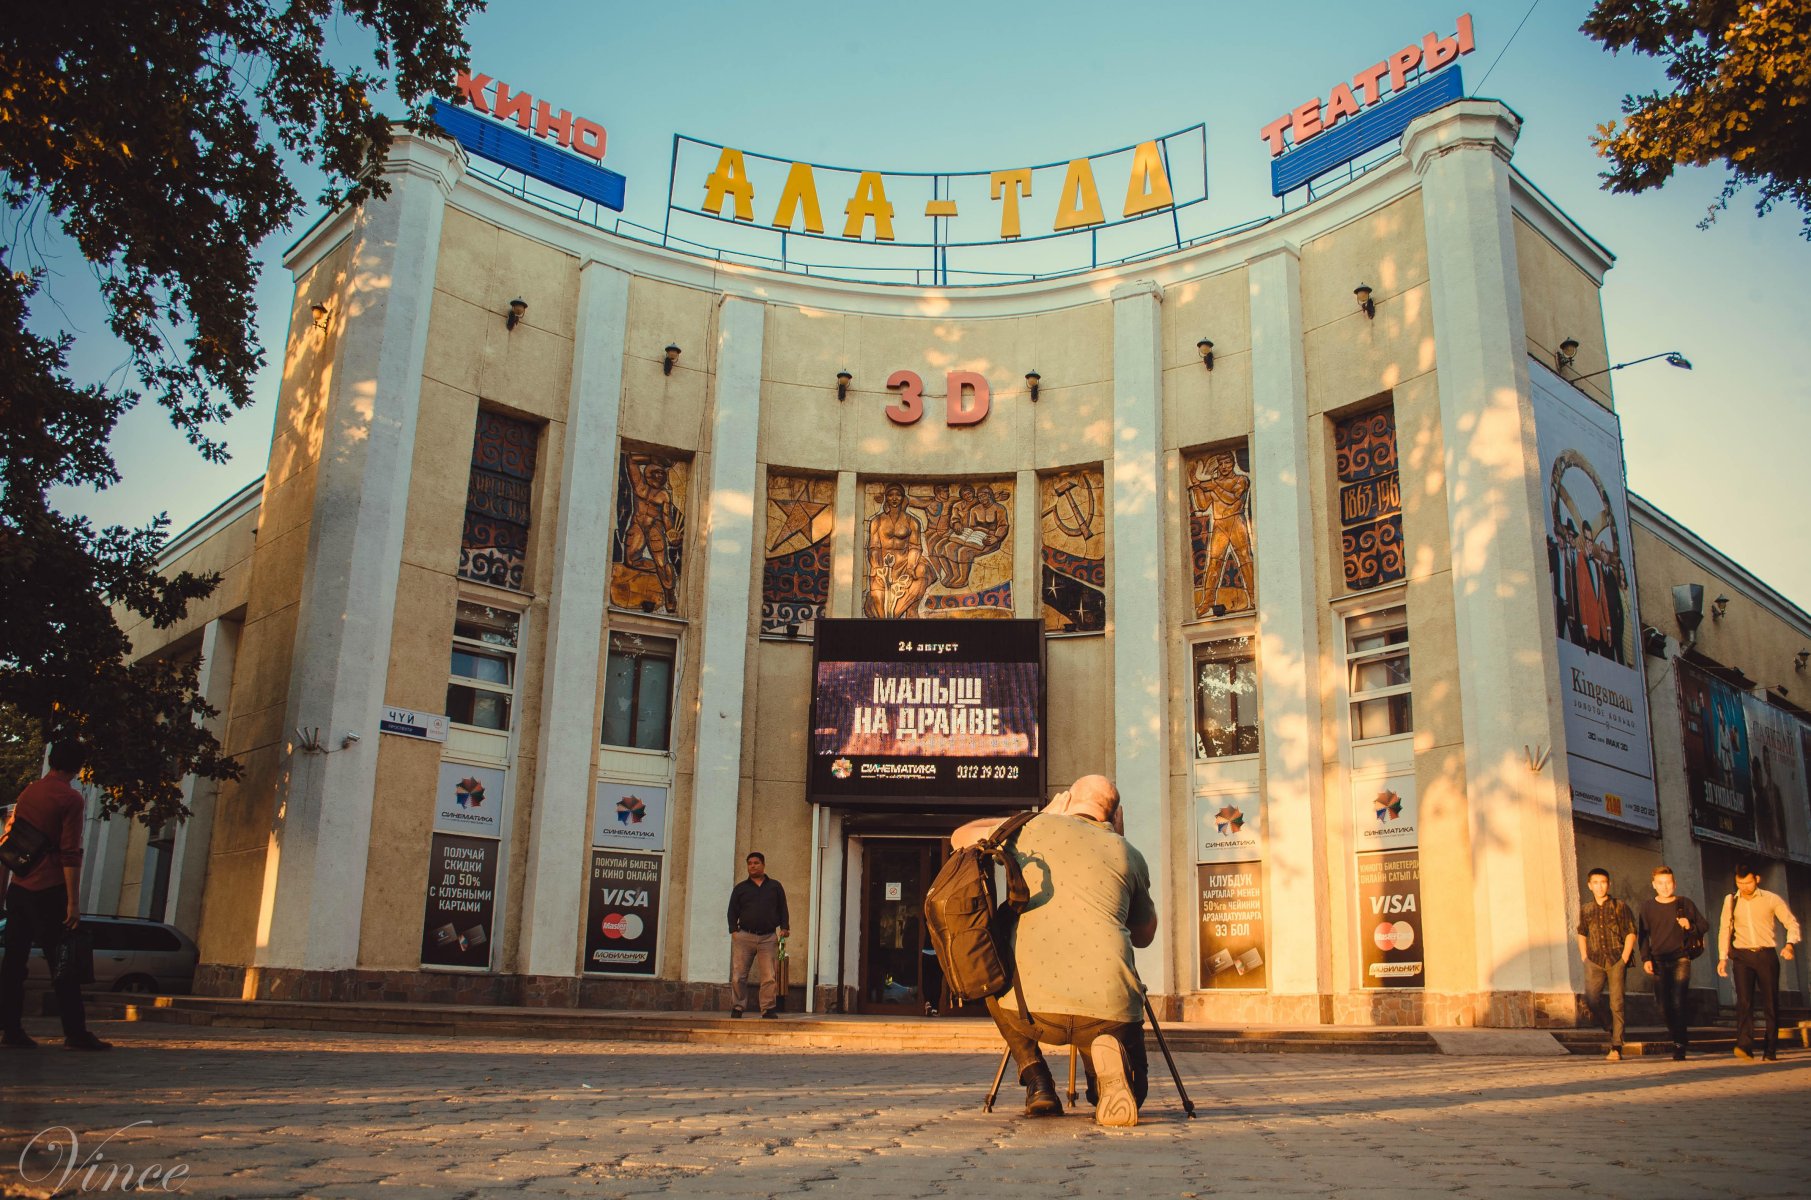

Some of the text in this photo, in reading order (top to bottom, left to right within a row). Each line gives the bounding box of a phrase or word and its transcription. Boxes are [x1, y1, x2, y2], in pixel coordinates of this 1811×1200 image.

[1260, 12, 1476, 157] ТЕАТРЫ
[456, 70, 608, 160] КИНО
[1344, 474, 1401, 520] 1863-196
[899, 642, 912, 651] 24
[873, 677, 981, 705] МАЛЫШ
[1570, 667, 1634, 714] Kingsman
[854, 704, 1000, 740] НА ДРАЙВЕ
[1605, 737, 1620, 749] IMAX
[861, 764, 936, 774] СИНЕМАТИКА
[994, 765, 1006, 778] 20
[1007, 765, 1019, 778] 20
[442, 811, 493, 823] СИНЕМАТИКА
[603, 828, 656, 838] СИНЕМАТИКА
[1364, 826, 1413, 837] СИНЕМАТИКА
[1205, 840, 1256, 848] СИНЕМАТИКА
[444, 846, 485, 860] ПОЛУЧАЙ
[444, 859, 482, 872] СКИДКИ
[595, 857, 658, 870] ПОКУПАЙ БИЛЕТЫ
[442, 873, 481, 886] ДО 50%
[594, 868, 657, 881] В КИНО ОНЛАЙН
[1209, 874, 1252, 887] КЛУБДУК
[1360, 872, 1387, 883] ОНЛАЙН
[1388, 871, 1411, 882] САТЫП
[430, 886, 492, 901] С КЛУБНЫМИ
[601, 888, 648, 907] VISA
[1203, 889, 1235, 899] КАРТАЛАР
[439, 899, 481, 912] КАРТАМИ
[1369, 893, 1416, 914] VISA
[1231, 923, 1250, 936] БОЛ
[595, 951, 646, 960] МОБИЛЬНИК
